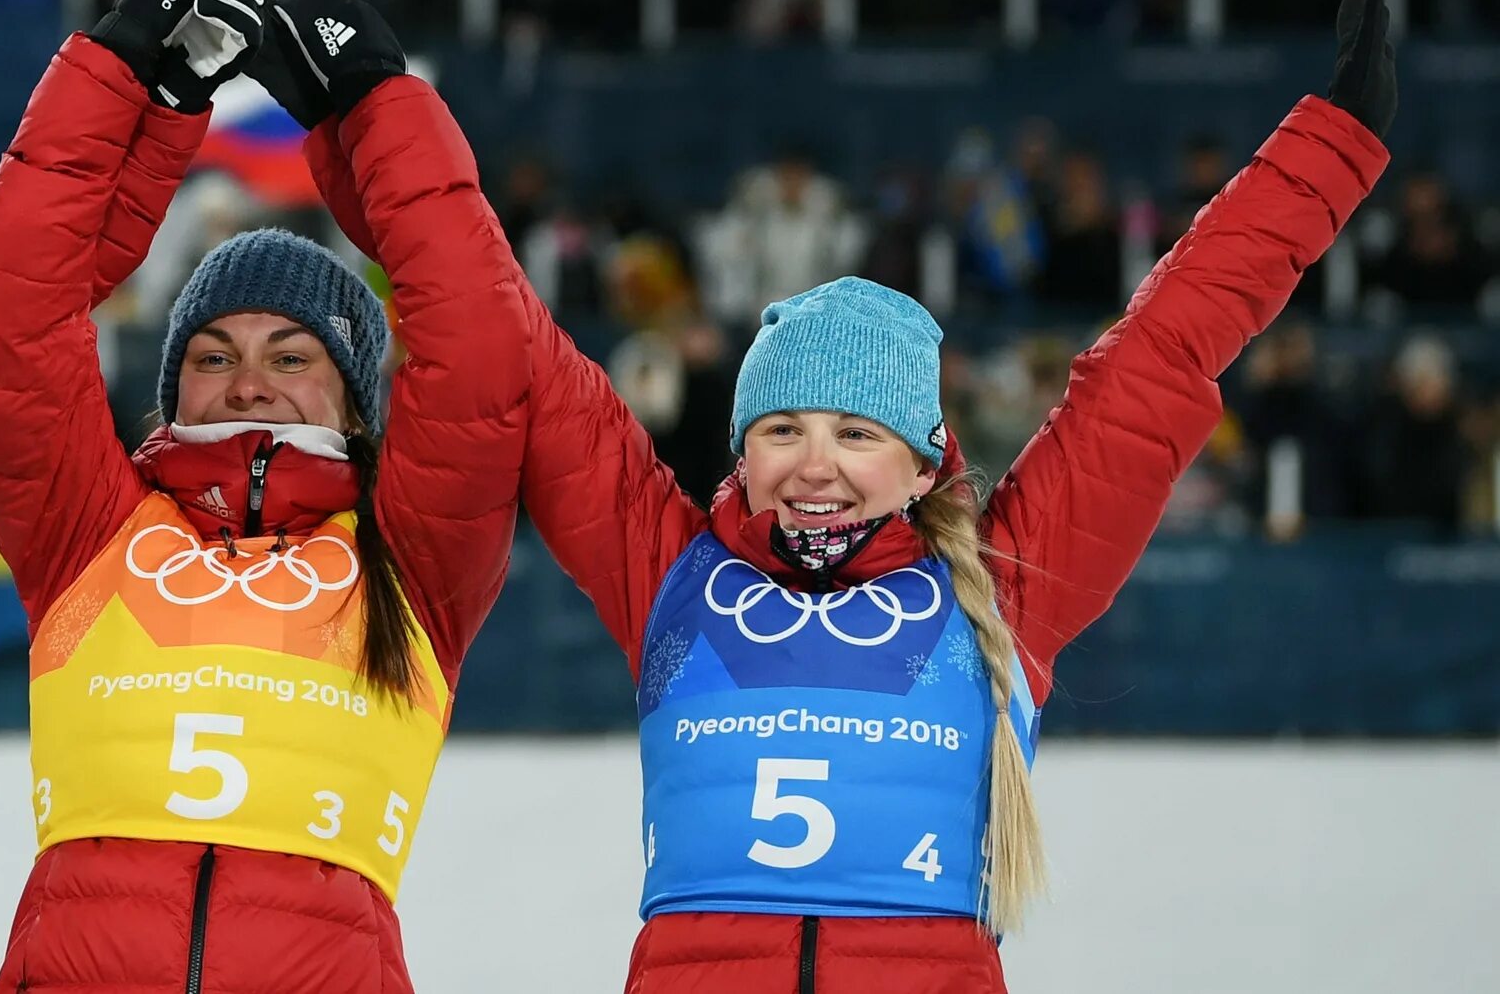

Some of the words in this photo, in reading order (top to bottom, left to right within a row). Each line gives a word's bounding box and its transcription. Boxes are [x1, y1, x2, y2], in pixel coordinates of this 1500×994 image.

[314, 17, 340, 57] adidas
[88, 664, 295, 702] PyeongChang
[302, 679, 369, 717] 2018
[674, 708, 884, 744] PyeongChang
[163, 712, 249, 821] 5
[34, 778, 52, 825] 3
[306, 790, 344, 840] 3
[376, 790, 410, 857] 5
[746, 758, 837, 869] 5
[902, 833, 943, 883] 4
